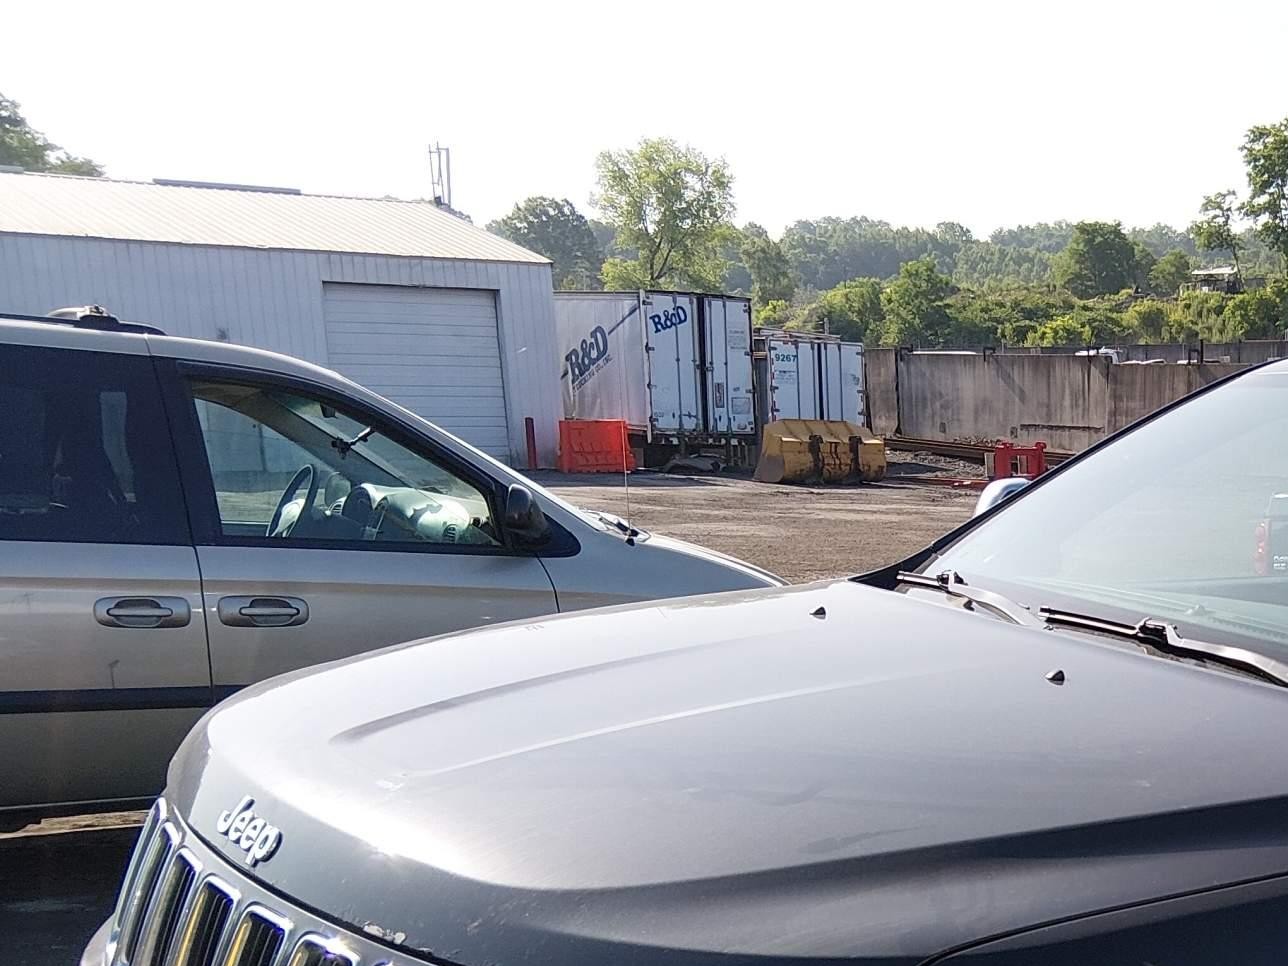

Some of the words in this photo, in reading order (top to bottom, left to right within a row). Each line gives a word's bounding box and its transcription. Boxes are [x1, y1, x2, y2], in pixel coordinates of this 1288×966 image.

[649, 305, 688, 334] R&D
[565, 325, 609, 385] R&D
[775, 353, 798, 363] 9267
[217, 794, 283, 868] Jeep
